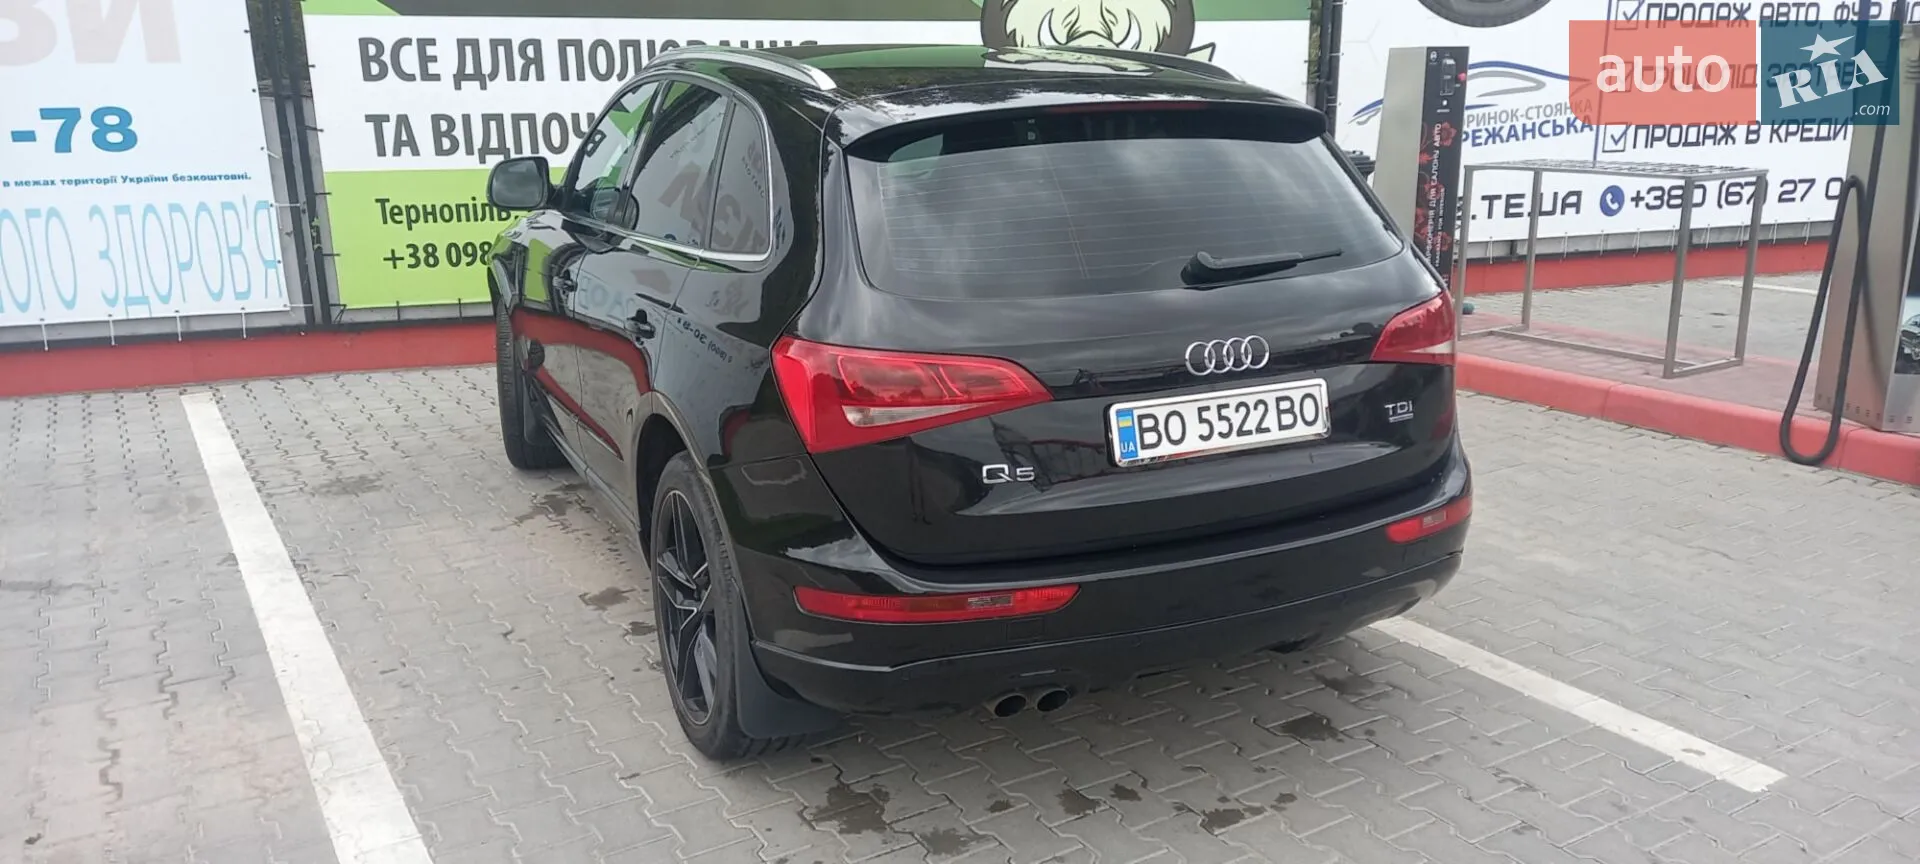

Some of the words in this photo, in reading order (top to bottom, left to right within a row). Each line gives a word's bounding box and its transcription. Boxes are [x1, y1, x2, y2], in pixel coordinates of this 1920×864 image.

[358, 37, 441, 83] ВСЕ
[453, 37, 545, 90] ДЛЯ
[1463, 99, 1592, 129] РИНОК-СТОЯНКА
[11, 106, 138, 153] -78
[365, 114, 421, 157] ТА
[14, 178, 57, 187] межах
[60, 174, 118, 186] території
[121, 173, 169, 185] України
[1778, 178, 1816, 203] 27
[383, 242, 440, 269] +38
[1197, 399, 1272, 442] 5522
[1384, 400, 1413, 416] TDI
[1121, 442, 1136, 454] UA
[982, 464, 1035, 484] Q5
